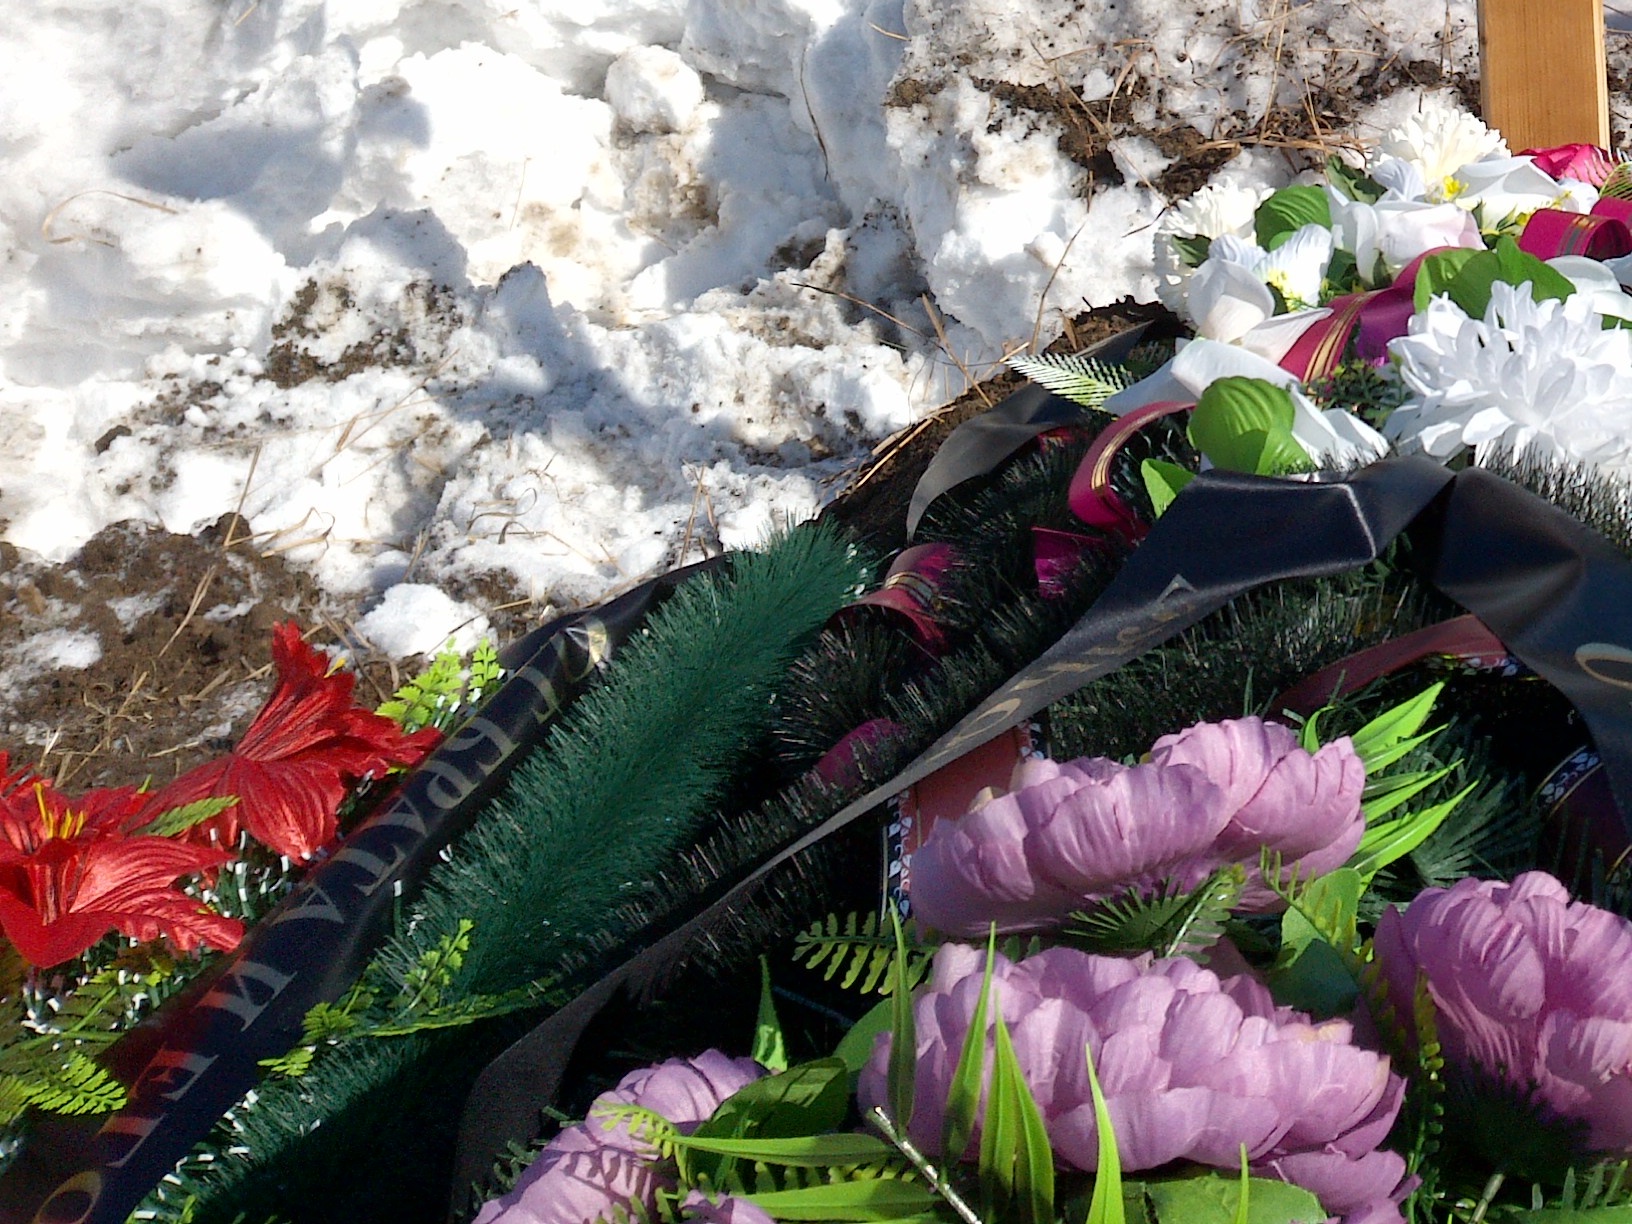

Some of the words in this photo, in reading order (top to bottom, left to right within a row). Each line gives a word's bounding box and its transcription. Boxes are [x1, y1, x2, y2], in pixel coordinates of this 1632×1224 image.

[258, 715, 521, 927] БРАТА
[196, 960, 298, 1033] И
[32, 1041, 219, 1224] ЕГО
